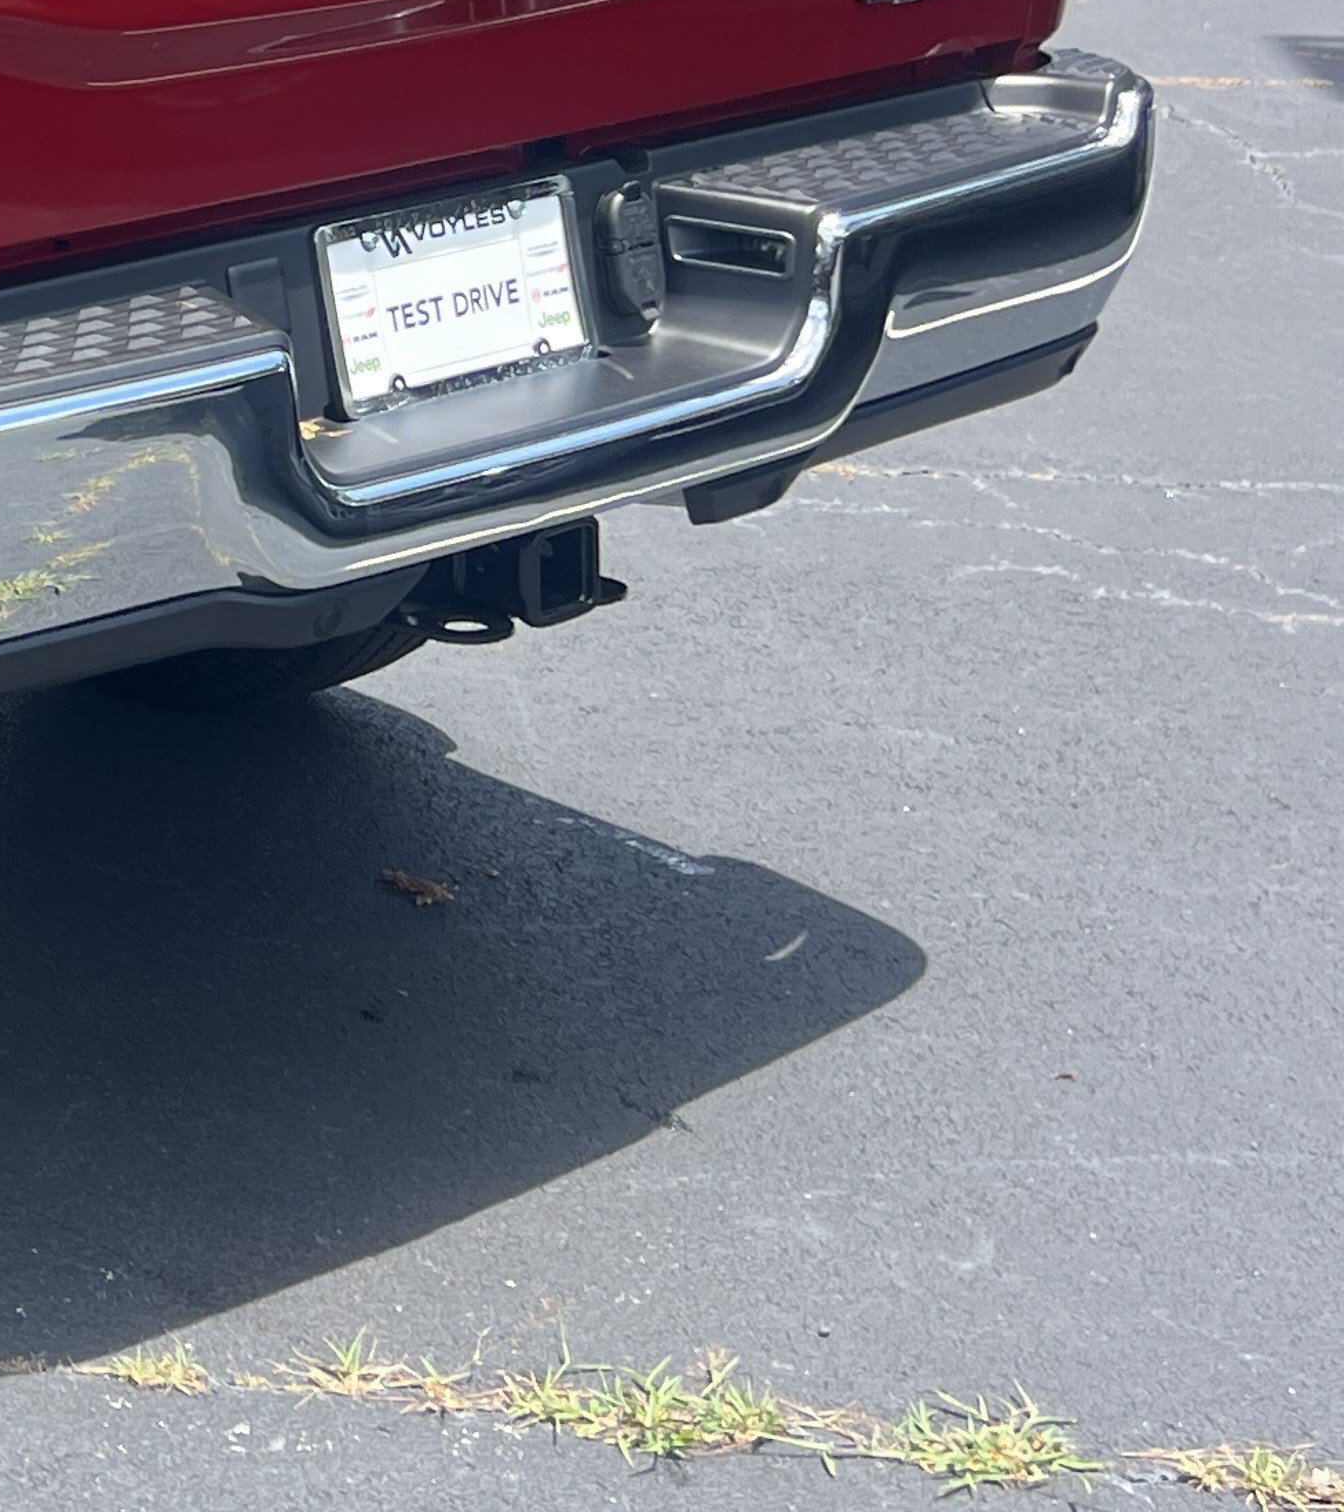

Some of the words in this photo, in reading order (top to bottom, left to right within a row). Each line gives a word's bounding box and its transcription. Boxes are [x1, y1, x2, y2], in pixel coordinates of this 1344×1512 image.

[412, 208, 506, 241] VOYLES
[386, 296, 445, 333] TEST
[453, 278, 521, 318] DRIVE
[538, 311, 571, 328] Jeep
[350, 357, 381, 376] Jeep
